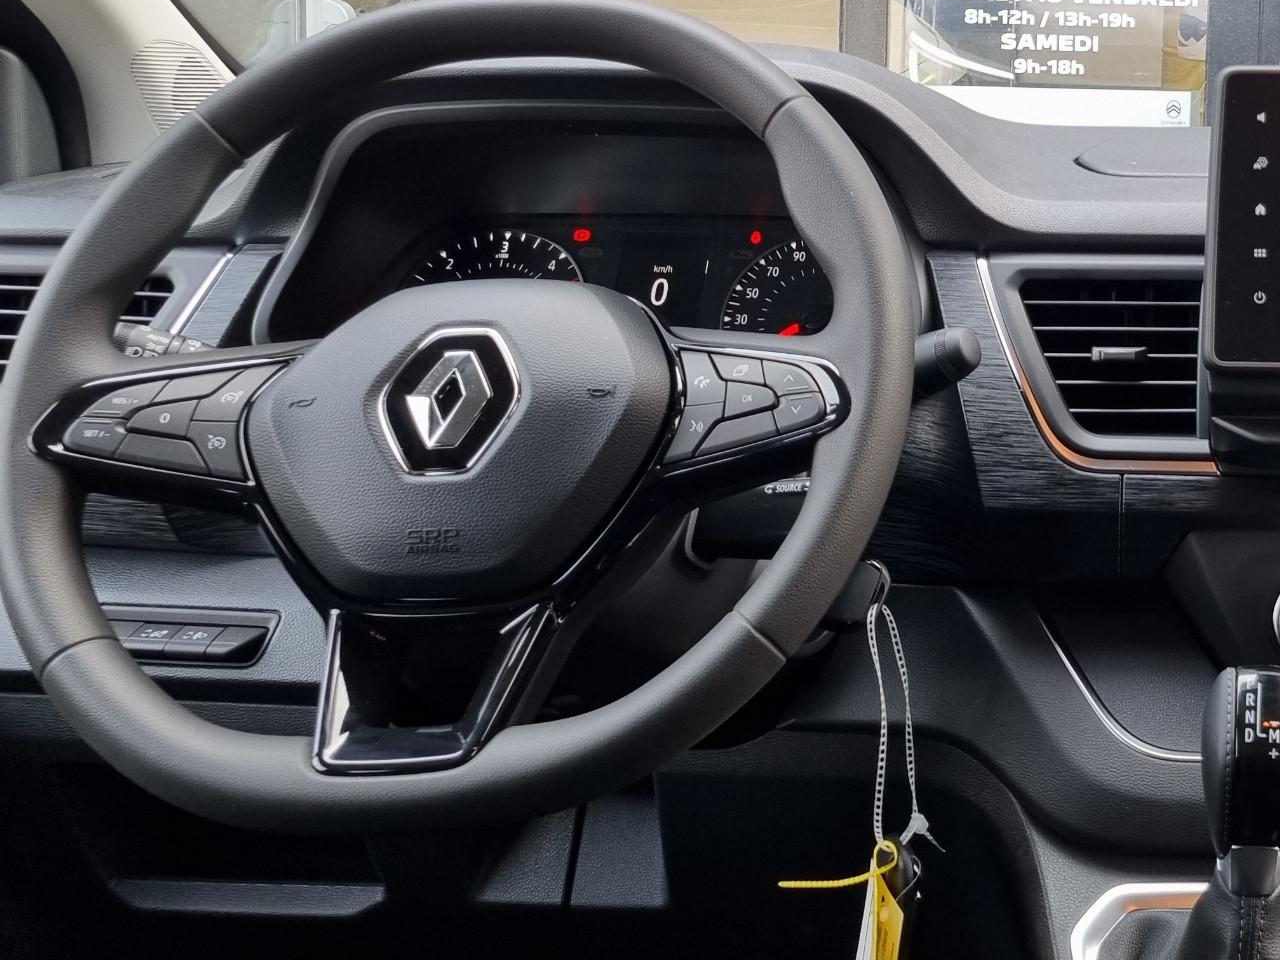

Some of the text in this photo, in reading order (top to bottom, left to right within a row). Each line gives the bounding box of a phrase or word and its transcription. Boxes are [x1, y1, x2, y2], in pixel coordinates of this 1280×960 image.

[964, 8, 1136, 28] 8h-12h / 13h-19h
[1000, 32, 1099, 52] SAMEDI
[1013, 58, 1085, 76] 9h-18h
[500, 242, 509, 253] 3
[793, 251, 806, 263] 90
[445, 258, 454, 271] 2
[547, 260, 556, 271] 4
[653, 265, 673, 275] km/h
[766, 266, 779, 277] 70
[650, 278, 669, 306] 0
[745, 287, 759, 300] 50
[734, 314, 748, 326] 30
[741, 393, 753, 404] OK
[775, 483, 803, 493] SOURCE
[1245, 692, 1256, 707] R
[1245, 709, 1256, 724] N
[1244, 727, 1255, 743] D
